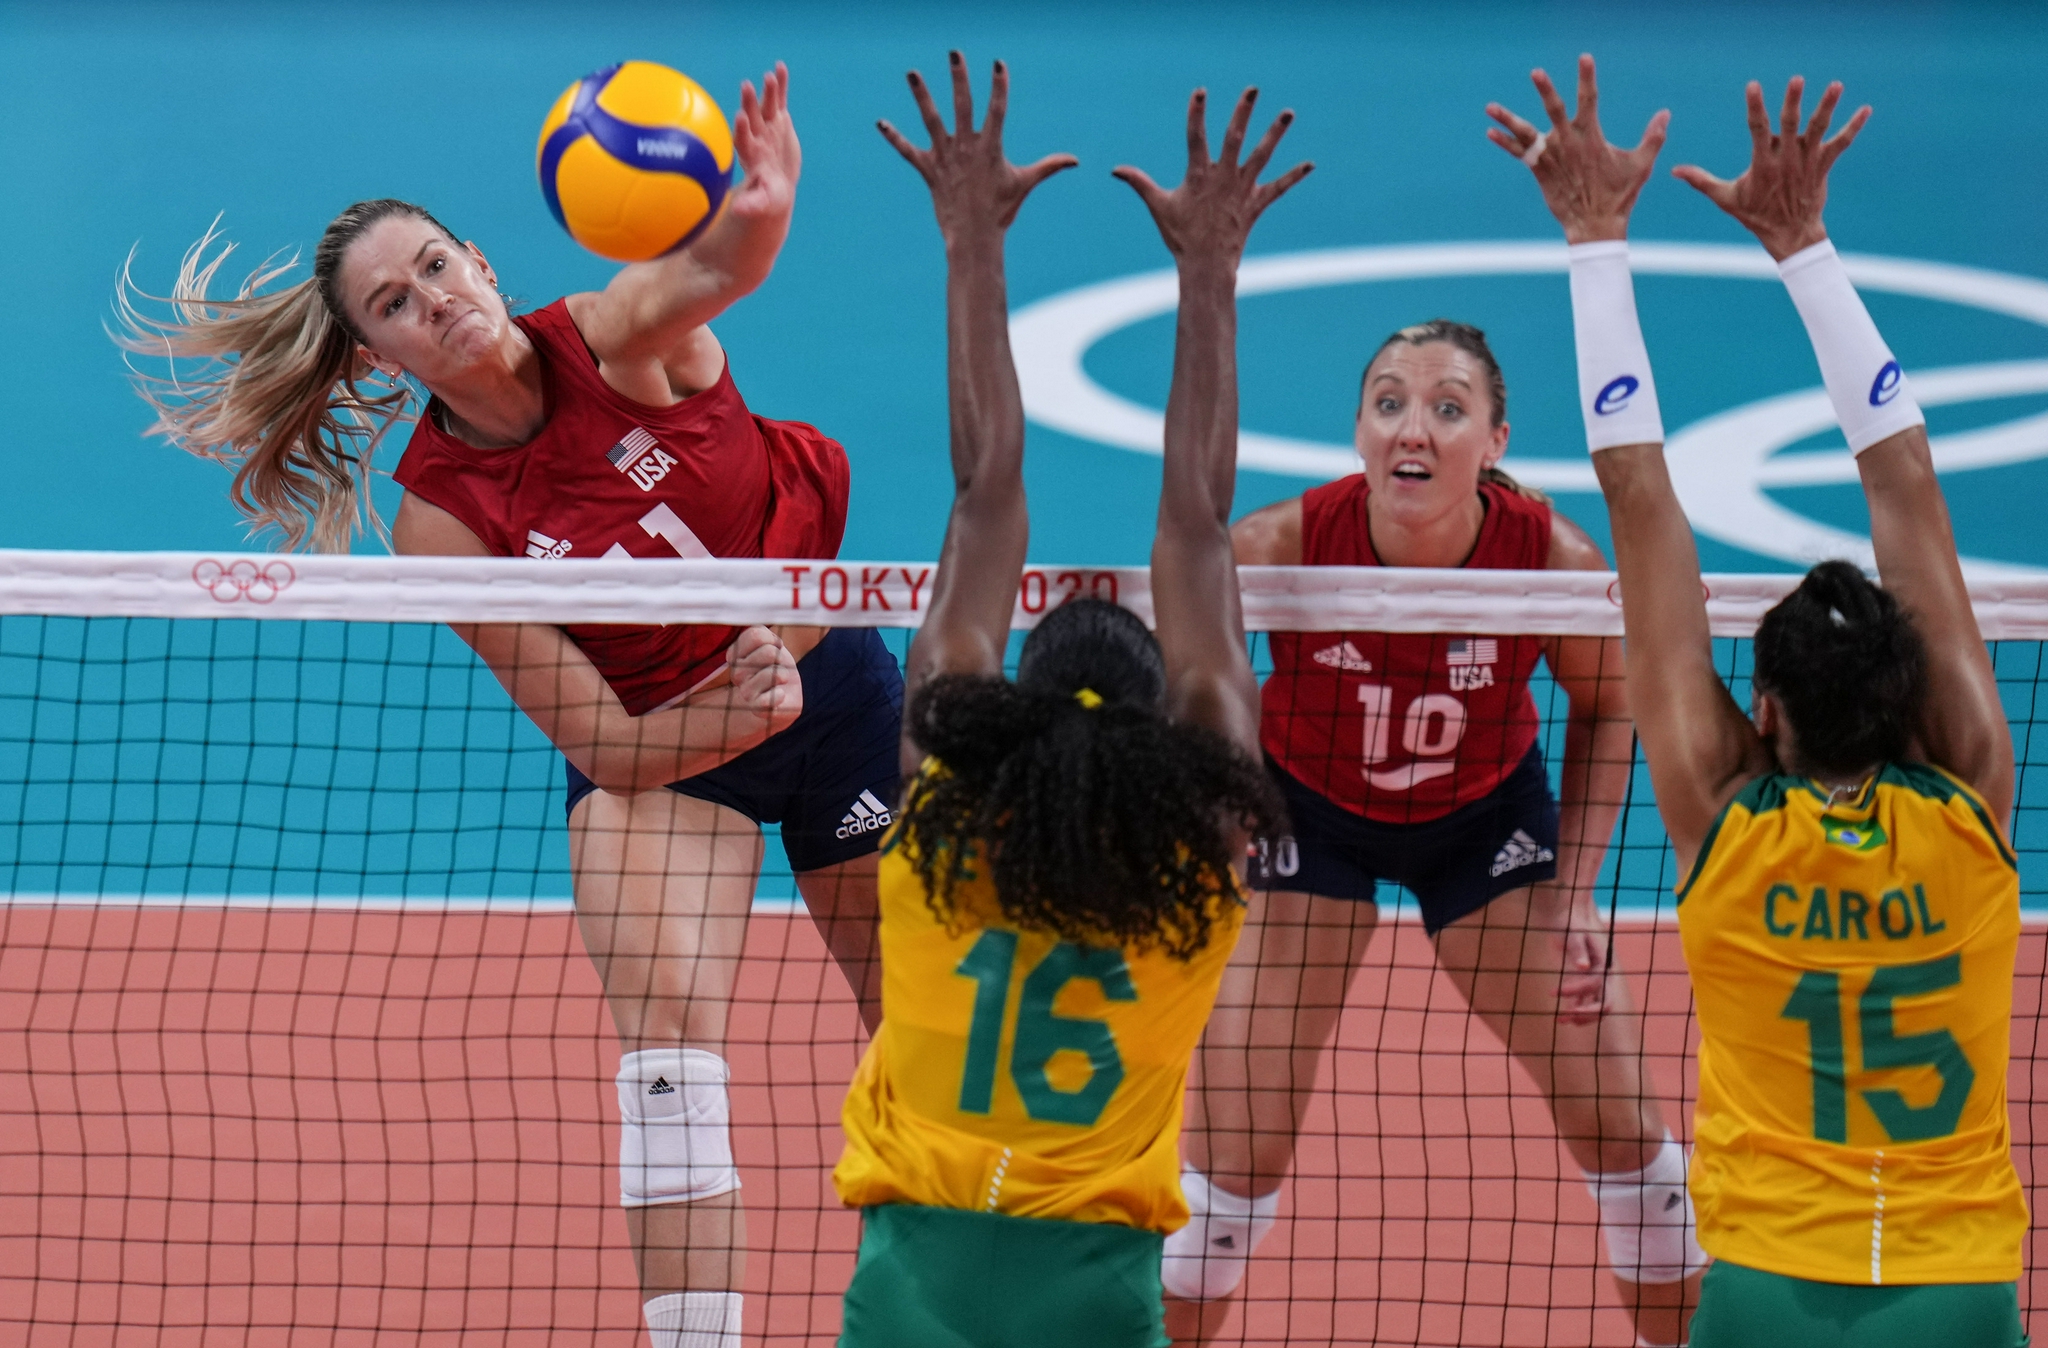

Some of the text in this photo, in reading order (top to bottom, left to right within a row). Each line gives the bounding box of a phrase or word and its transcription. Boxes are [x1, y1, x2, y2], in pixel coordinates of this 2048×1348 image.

[627, 447, 679, 492] USA
[783, 566, 1118, 614] TOKY 020
[1449, 664, 1494, 691] USA
[1357, 683, 1467, 791] 10
[1763, 881, 1946, 941] CAROL
[953, 927, 1139, 1128] 16
[1780, 951, 1976, 1145] 15
[648, 1086, 675, 1095] adidas
